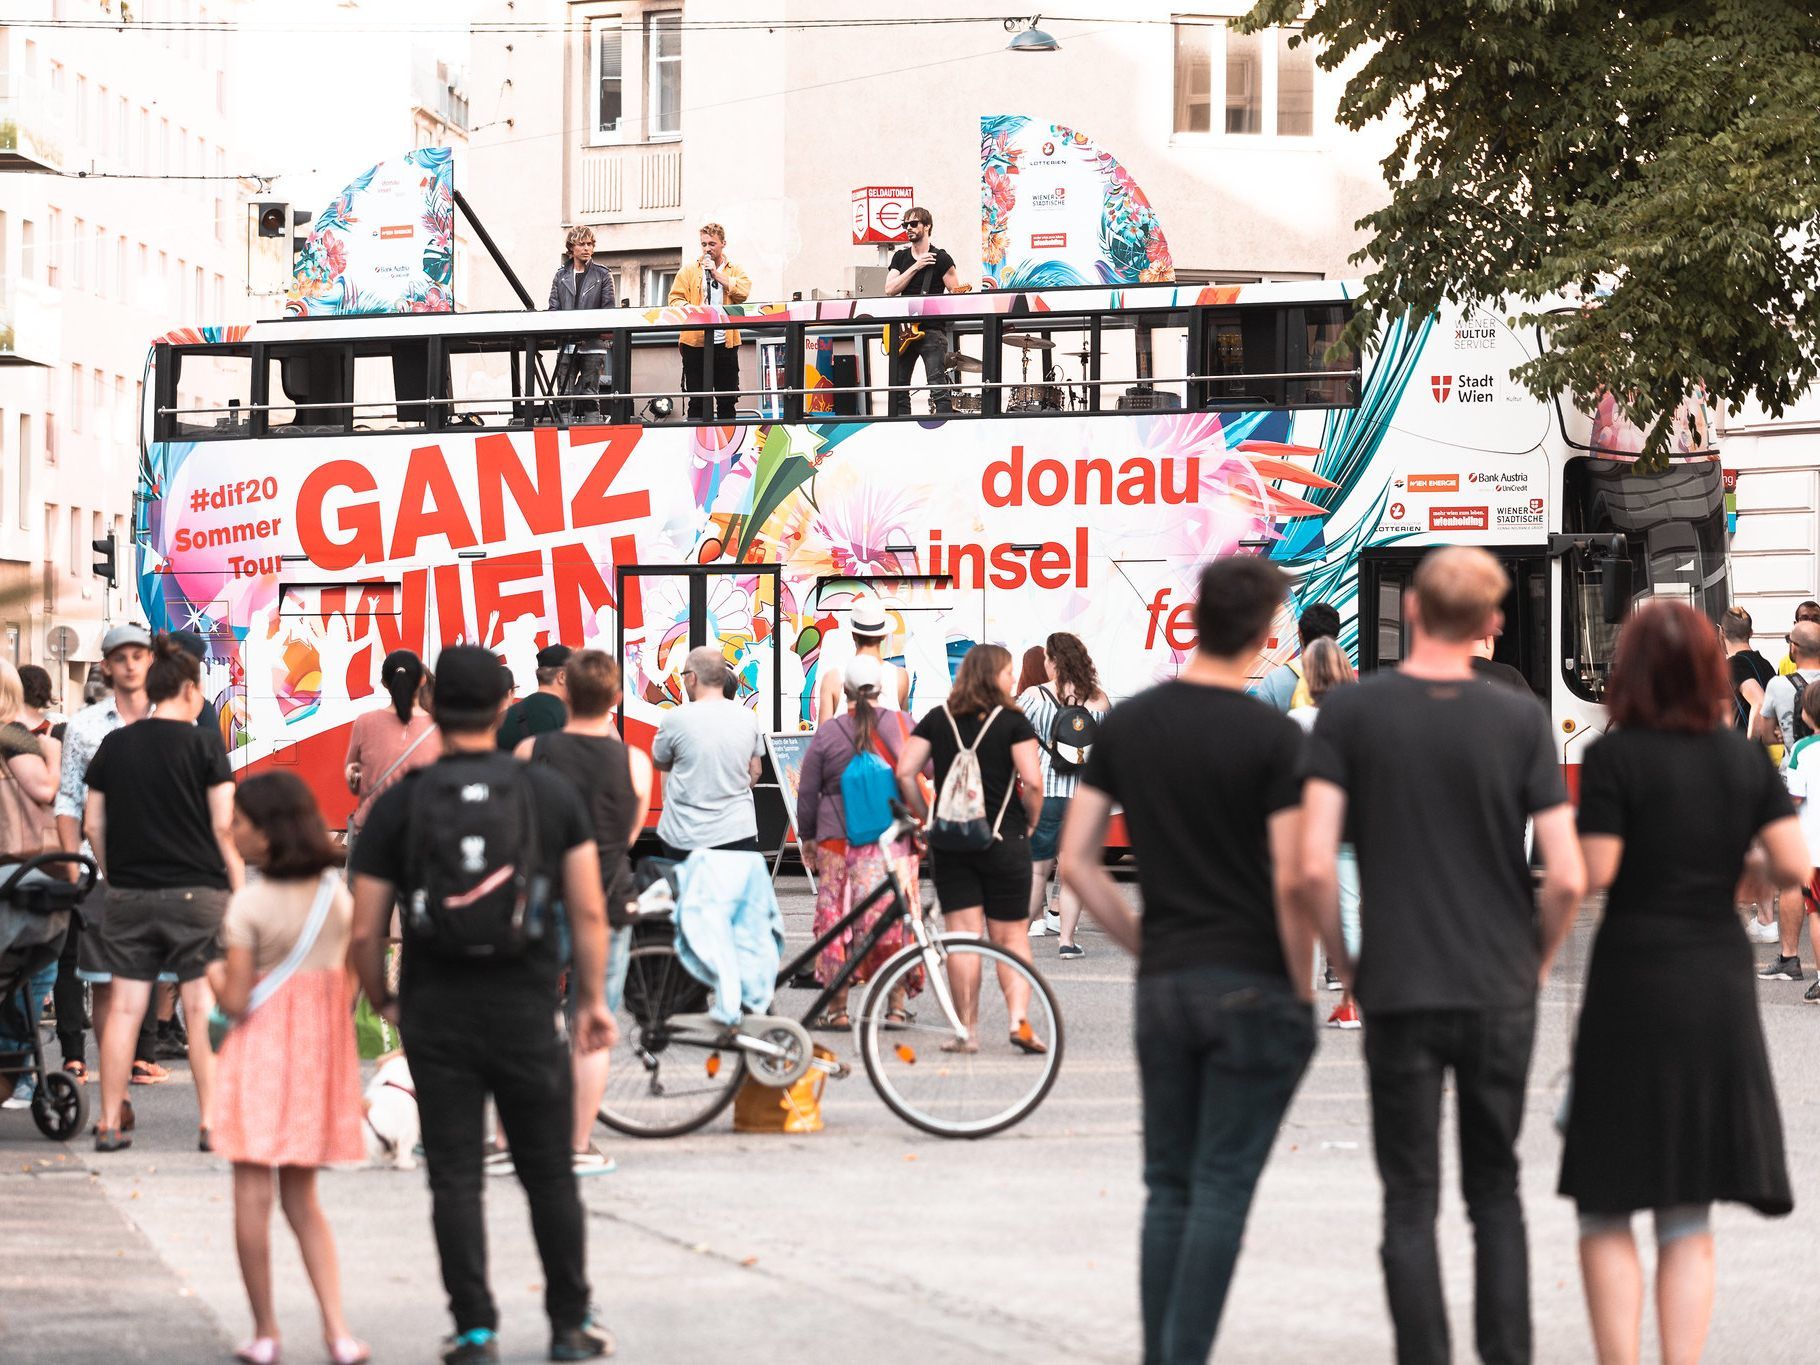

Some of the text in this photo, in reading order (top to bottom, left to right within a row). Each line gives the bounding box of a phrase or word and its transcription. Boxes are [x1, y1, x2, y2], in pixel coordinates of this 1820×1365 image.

[868, 188, 912, 197] GELDAUTOMAT
[1455, 319, 1496, 328] WIENER
[1455, 329, 1496, 338] KULTUR
[1454, 339, 1496, 349] SERVICE
[1458, 374, 1493, 387] Stadt
[1458, 390, 1493, 403] Wien
[981, 446, 1200, 507] donau
[1428, 479, 1457, 487] ENERGIE
[1478, 472, 1528, 482] Bank Austria
[1722, 475, 1734, 487] ng
[190, 476, 278, 512] #dif20
[296, 424, 651, 571] GANZ
[1433, 516, 1484, 527] wienholding
[175, 518, 282, 552] Sommer
[928, 527, 1088, 590] insel
[228, 555, 281, 579] Tour
[1144, 588, 1278, 650] fe.
